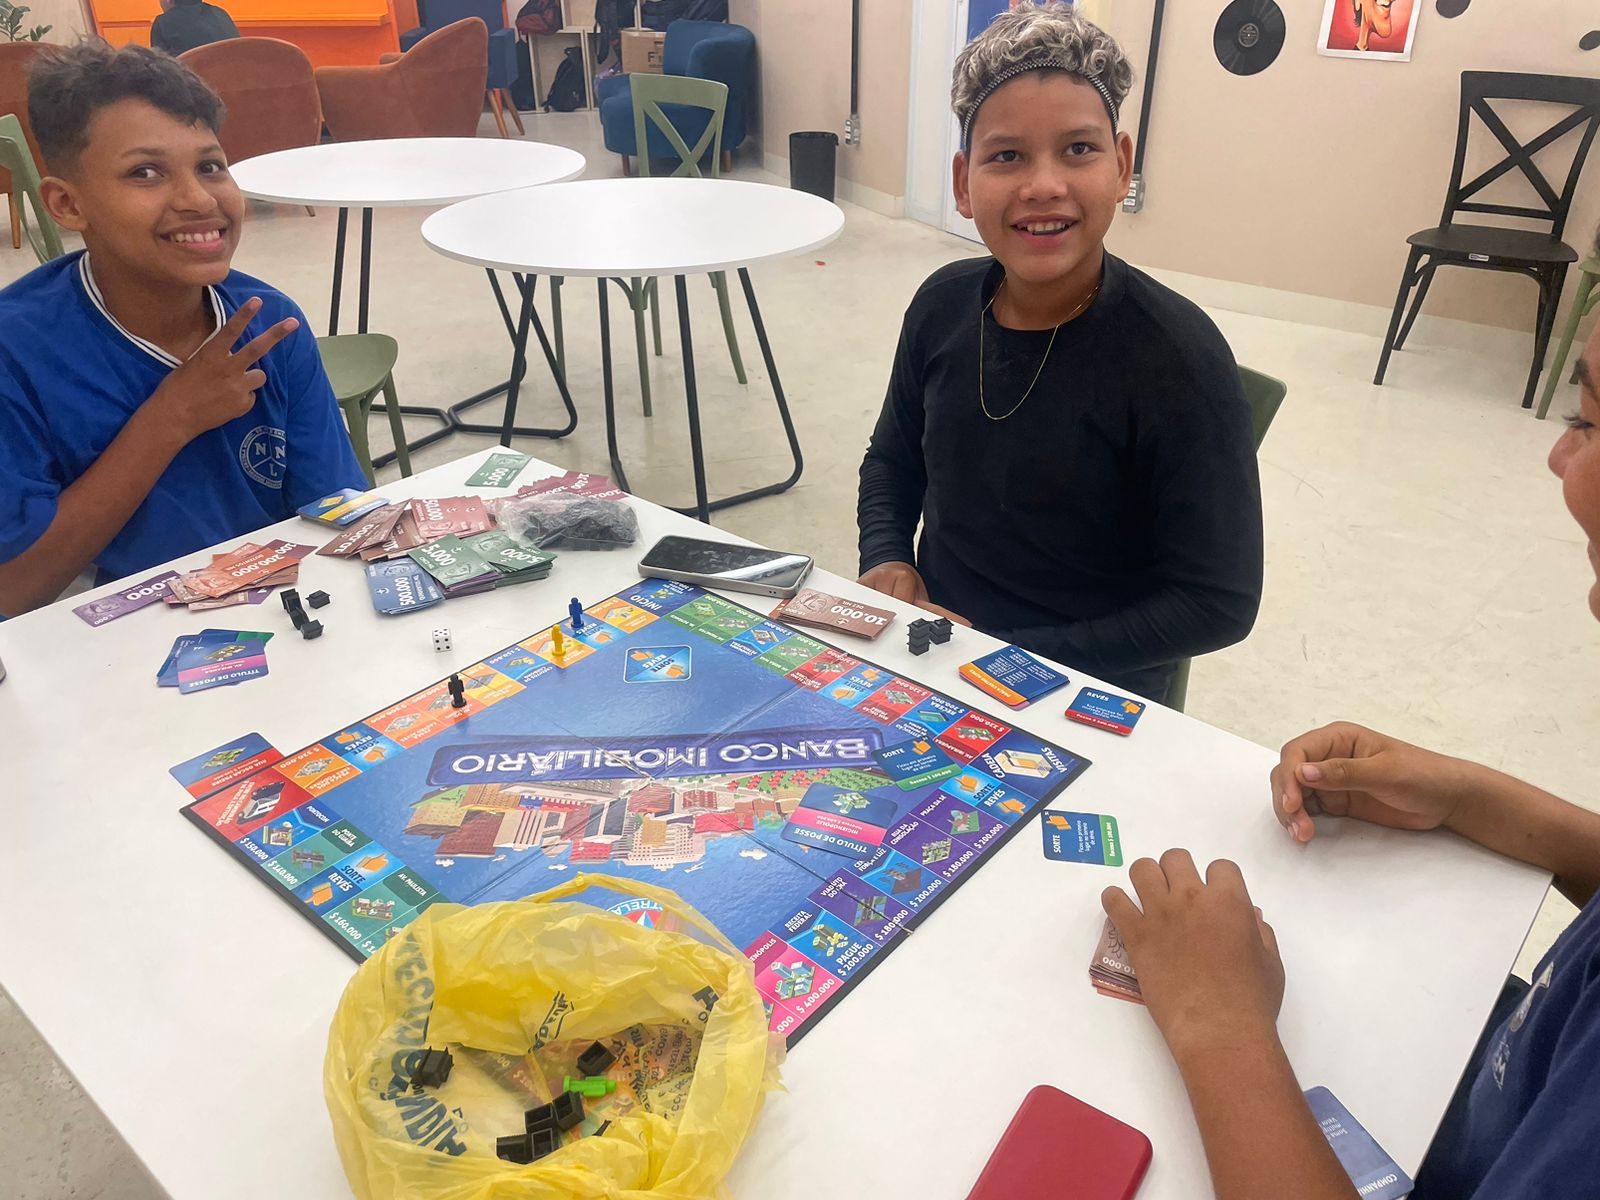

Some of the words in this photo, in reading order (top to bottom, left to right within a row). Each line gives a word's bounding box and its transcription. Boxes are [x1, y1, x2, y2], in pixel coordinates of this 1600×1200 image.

[255, 442, 266, 456] N
[422, 544, 457, 566] 5.000
[500, 548, 545, 564] 5.000
[232, 556, 285, 577] 200.000
[395, 577, 415, 606] 500.000
[630, 595, 661, 610] INÍCIO
[831, 605, 887, 626] 10.000
[851, 675, 874, 687] REVÉS
[1086, 691, 1109, 701] REVÉS
[930, 701, 957, 715] RECEBA
[970, 713, 999, 729] 220.000
[344, 735, 373, 751] REVÉS
[351, 740, 380, 755] SORTE
[720, 737, 870, 765] BANCO
[882, 748, 906, 758] SORTE
[452, 746, 707, 776] IMOBILIÁRIO
[981, 753, 1005, 778] CADEIA
[1040, 747, 1067, 773] VISITAS
[973, 783, 996, 801] SORTE
[984, 789, 1005, 808] REVÉS
[794, 828, 822, 841] POSSE
[823, 833, 836, 843] DE
[979, 823, 1004, 847] 200.000
[1052, 834, 1061, 853] SORTE
[246, 842, 269, 860] 150.000
[837, 838, 868, 854] TÍTULO
[949, 850, 973, 874] 180.000
[273, 865, 298, 885] 140.000
[328, 872, 353, 892] REVÉS
[341, 865, 366, 885] SORTE
[404, 877, 427, 897] PAULISTA
[916, 879, 942, 903] 200.000
[611, 900, 664, 915] TRELA
[335, 916, 362, 940] 160.000
[784, 910, 807, 929] RECEITA
[789, 912, 813, 933] FEDERAL
[750, 938, 777, 961] ENÓPOLIS
[836, 941, 862, 966] PAGUE
[845, 943, 874, 972] 200.000
[803, 978, 835, 1007] 400.000
